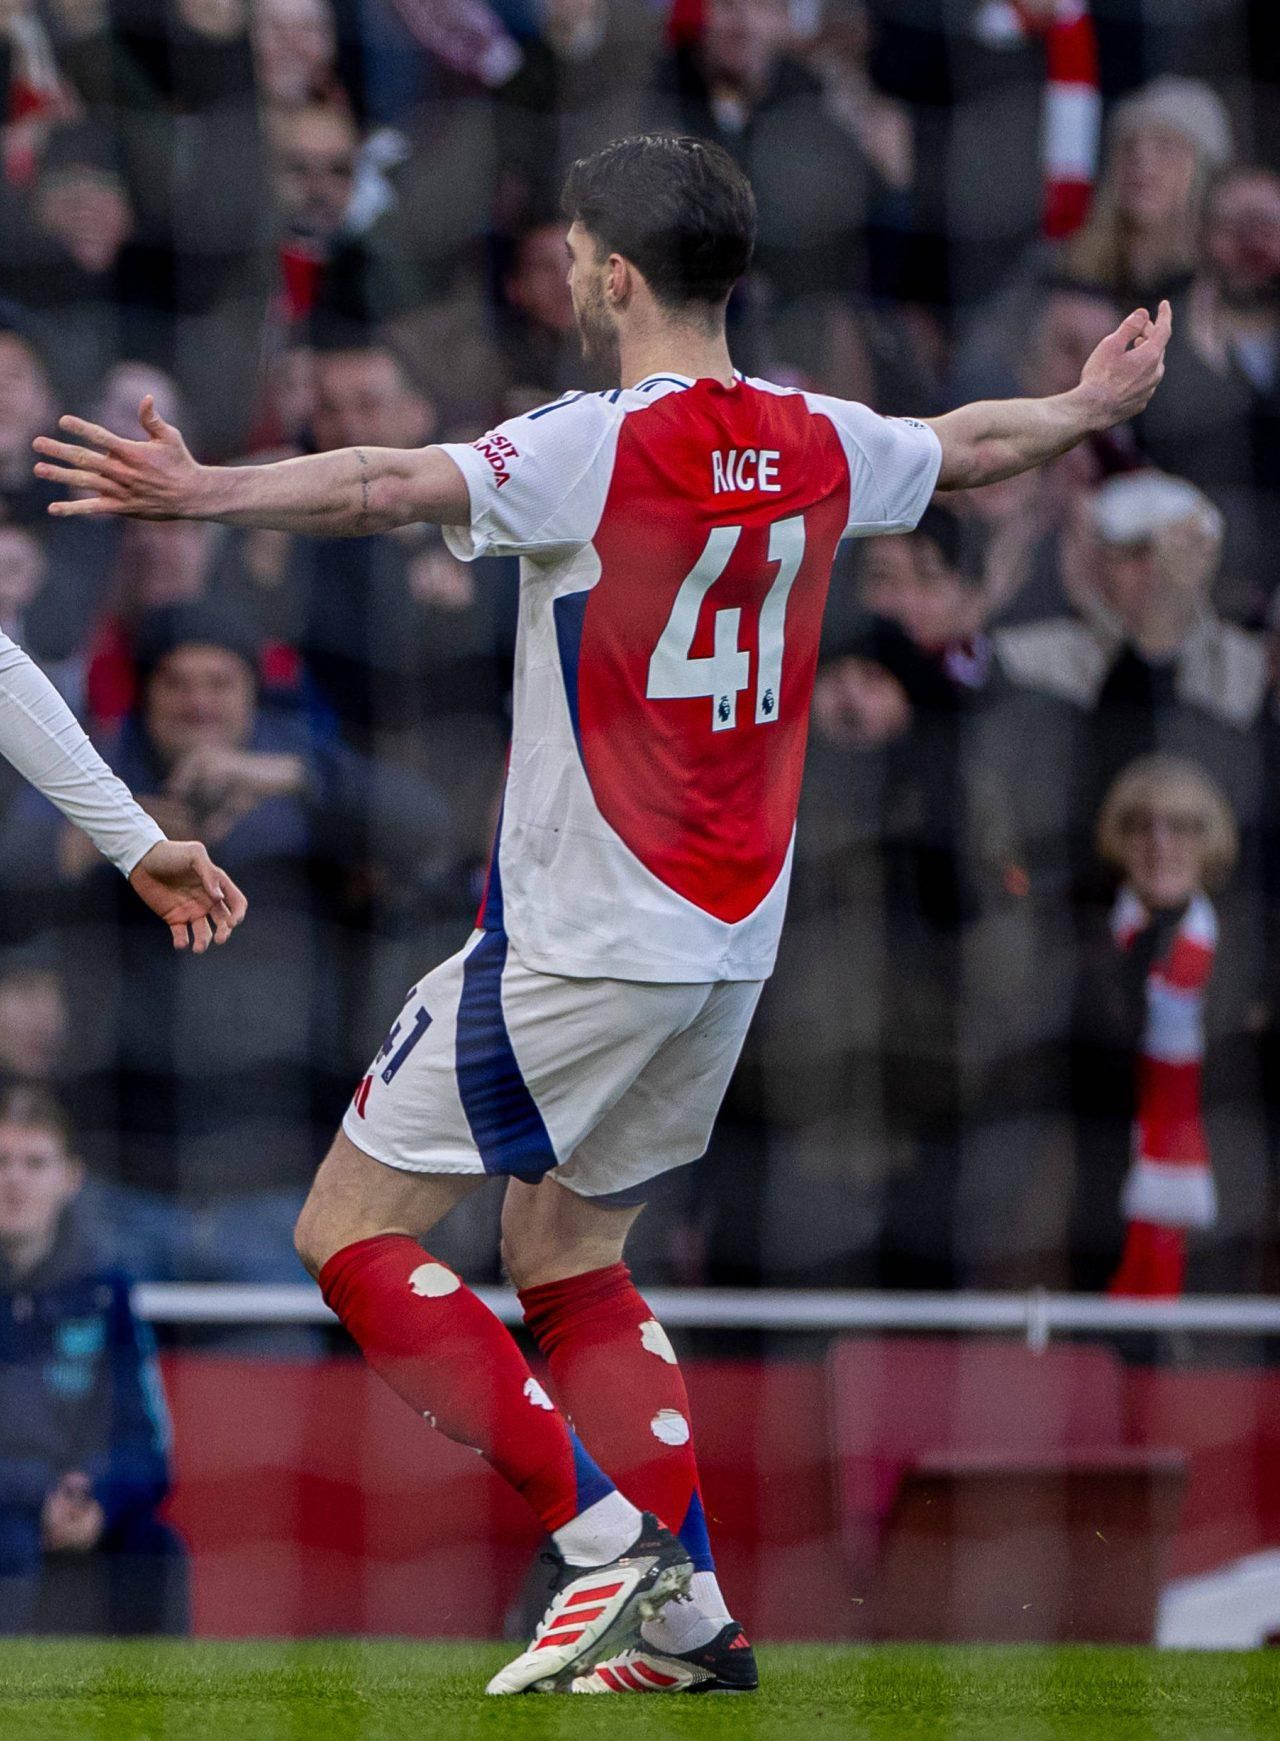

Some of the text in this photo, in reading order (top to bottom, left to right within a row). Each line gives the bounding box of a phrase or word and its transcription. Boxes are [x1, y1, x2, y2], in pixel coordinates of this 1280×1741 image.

[473, 443, 510, 489] NDA
[488, 433, 519, 457] SIT
[711, 449, 781, 494] RICE
[646, 514, 806, 732] 41
